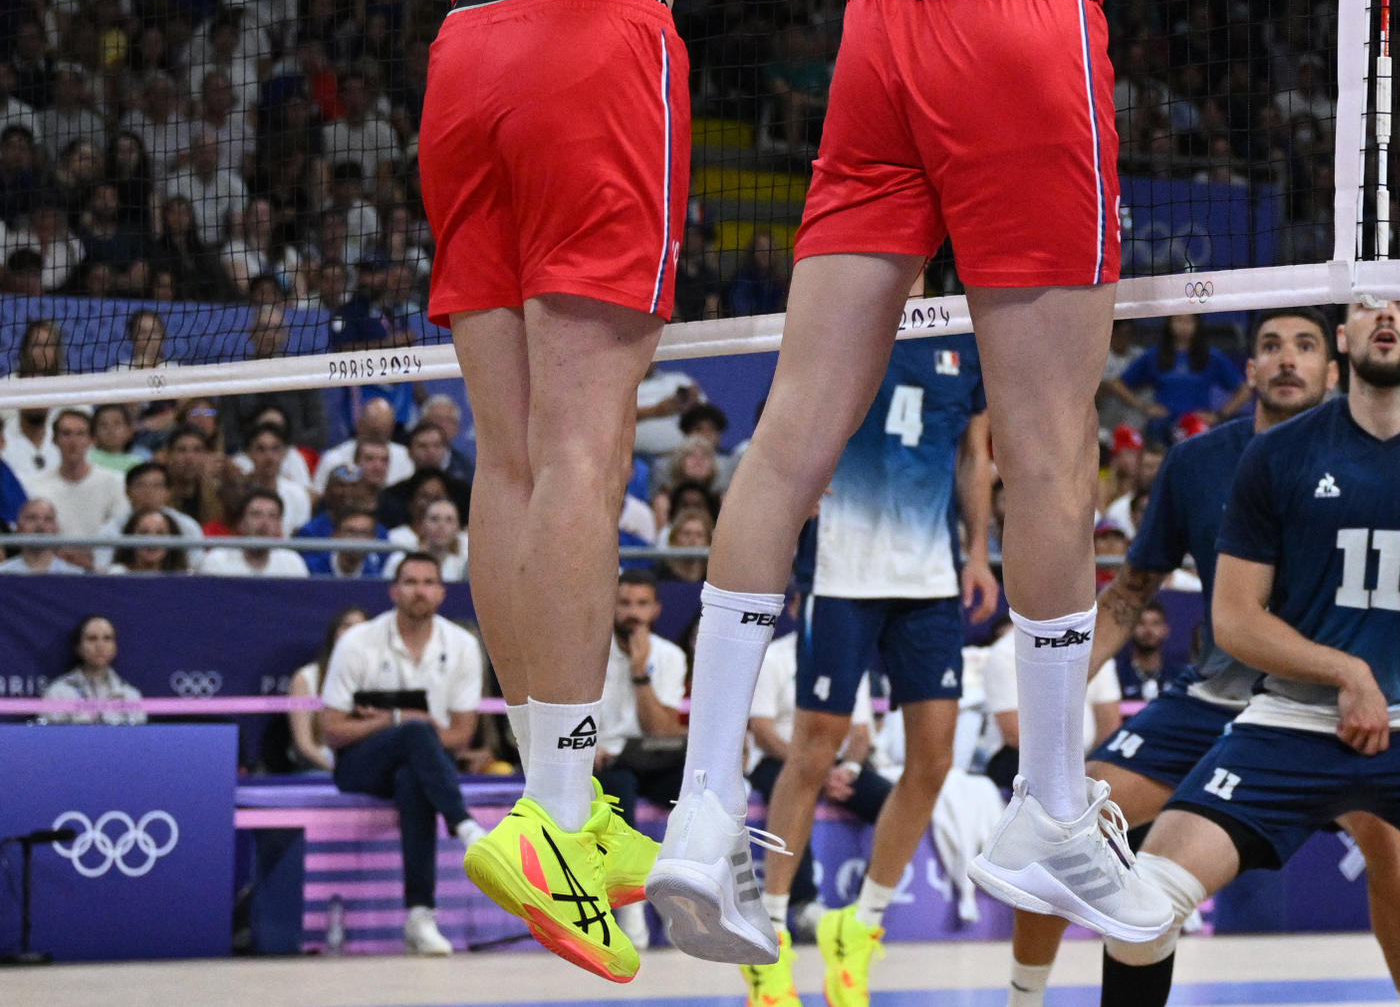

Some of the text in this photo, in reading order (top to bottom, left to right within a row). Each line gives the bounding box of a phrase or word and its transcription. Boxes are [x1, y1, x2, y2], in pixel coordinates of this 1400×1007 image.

[898, 306, 950, 331] 2024
[380, 354, 421, 376] 2024
[884, 384, 924, 448] 4
[1034, 630, 1092, 648] PEAK
[813, 675, 832, 701] 4
[557, 735, 598, 750] PEA
[1107, 730, 1145, 759] 14
[1203, 767, 1242, 800] 11
